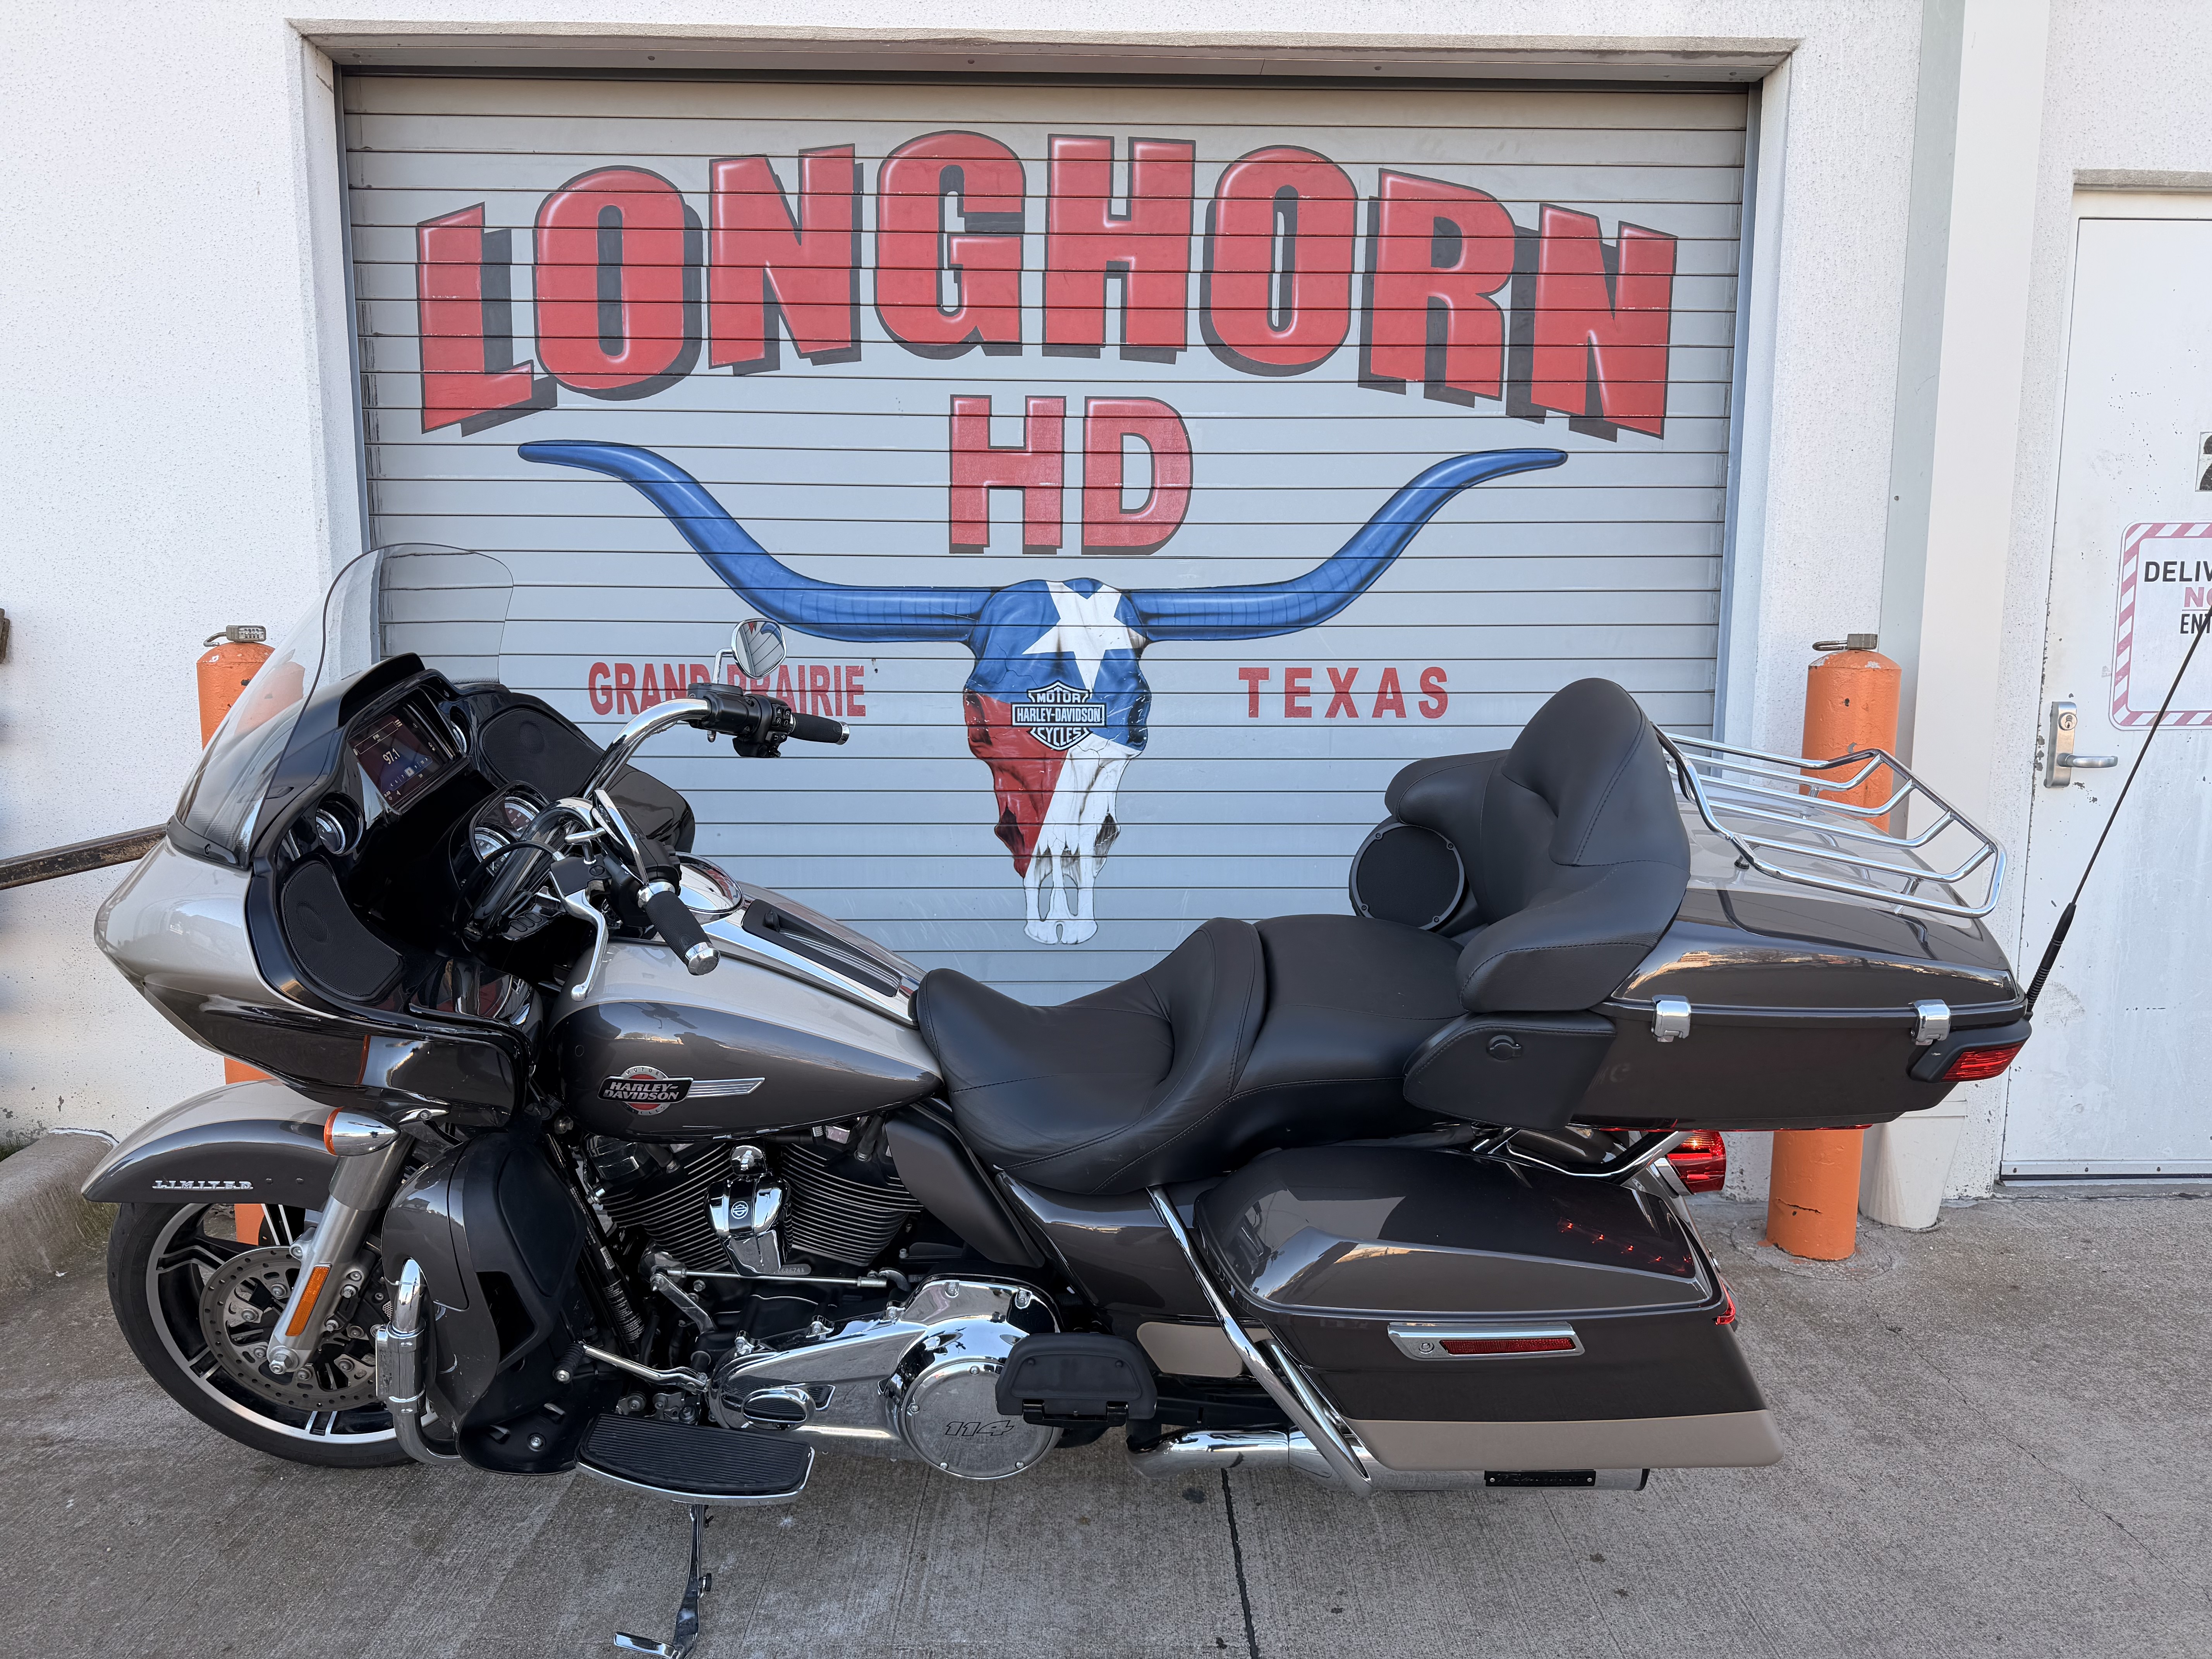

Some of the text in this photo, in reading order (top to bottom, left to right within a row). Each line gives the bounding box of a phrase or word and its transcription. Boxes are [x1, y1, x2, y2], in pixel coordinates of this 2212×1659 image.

[416, 130, 1677, 441] LONGHORN
[949, 395, 1193, 555] HD
[2184, 587, 2212, 607] N
[1037, 687, 1081, 703] MOTOR
[1239, 666, 1448, 719] TEXAS
[1017, 707, 1101, 723] HARLEY-DAVIDSON
[1037, 727, 1082, 747] CYCLES
[383, 748, 400, 764] 97.1
[625, 1067, 659, 1076] MOTOR
[603, 1089, 679, 1100] DAVIDSON
[610, 1082, 678, 1092] HARLEY-
[154, 1180, 253, 1190] LIMITED
[945, 1420, 1015, 1436] 114
